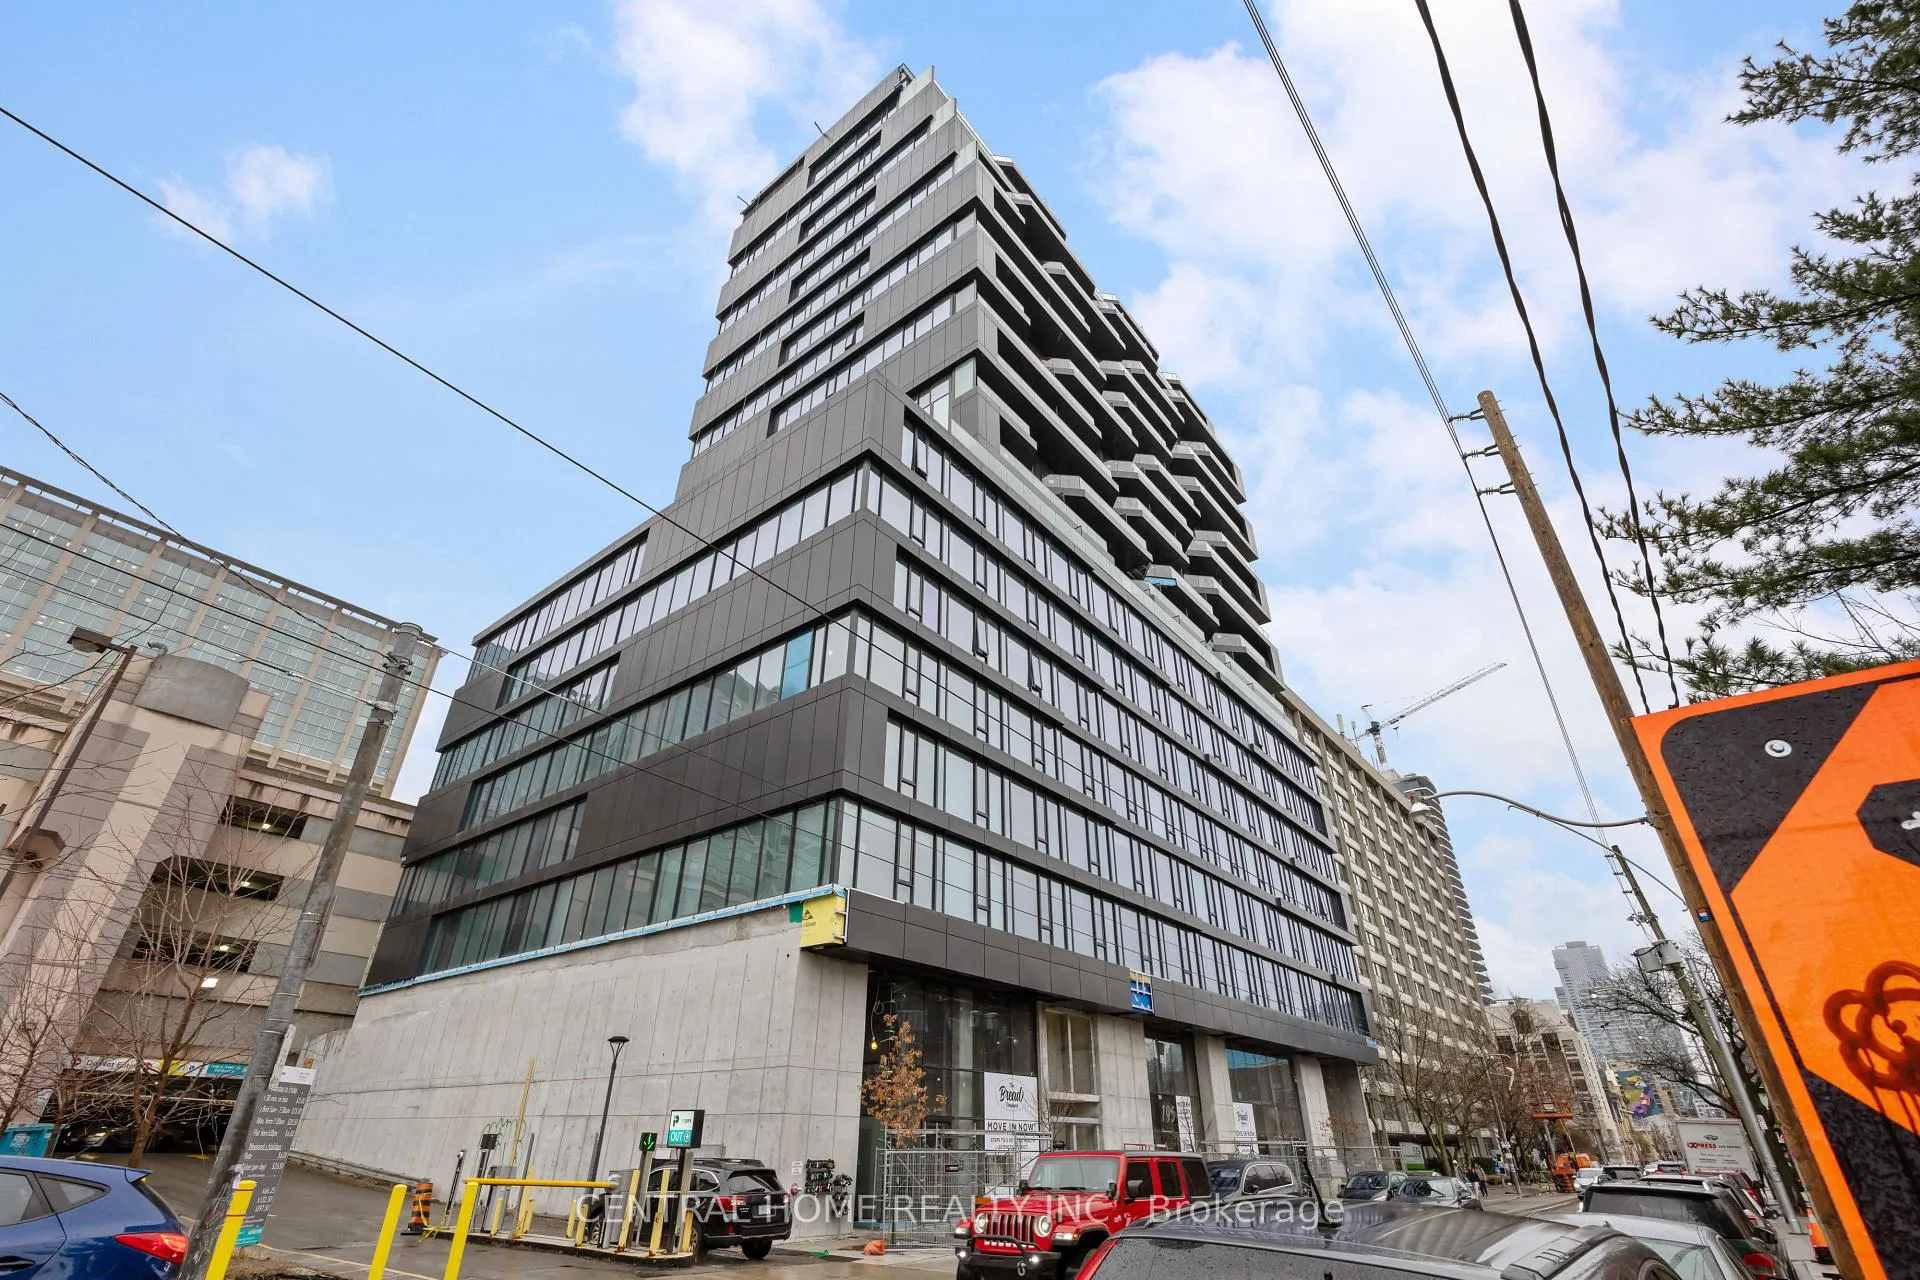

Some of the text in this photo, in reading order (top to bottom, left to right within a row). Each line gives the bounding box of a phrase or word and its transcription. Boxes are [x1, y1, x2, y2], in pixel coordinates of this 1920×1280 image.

[999, 1086, 1024, 1102] Bread
[988, 1122, 1006, 1131] MOVE
[1019, 1123, 1033, 1131] NOW
[670, 1131, 684, 1142] OUT
